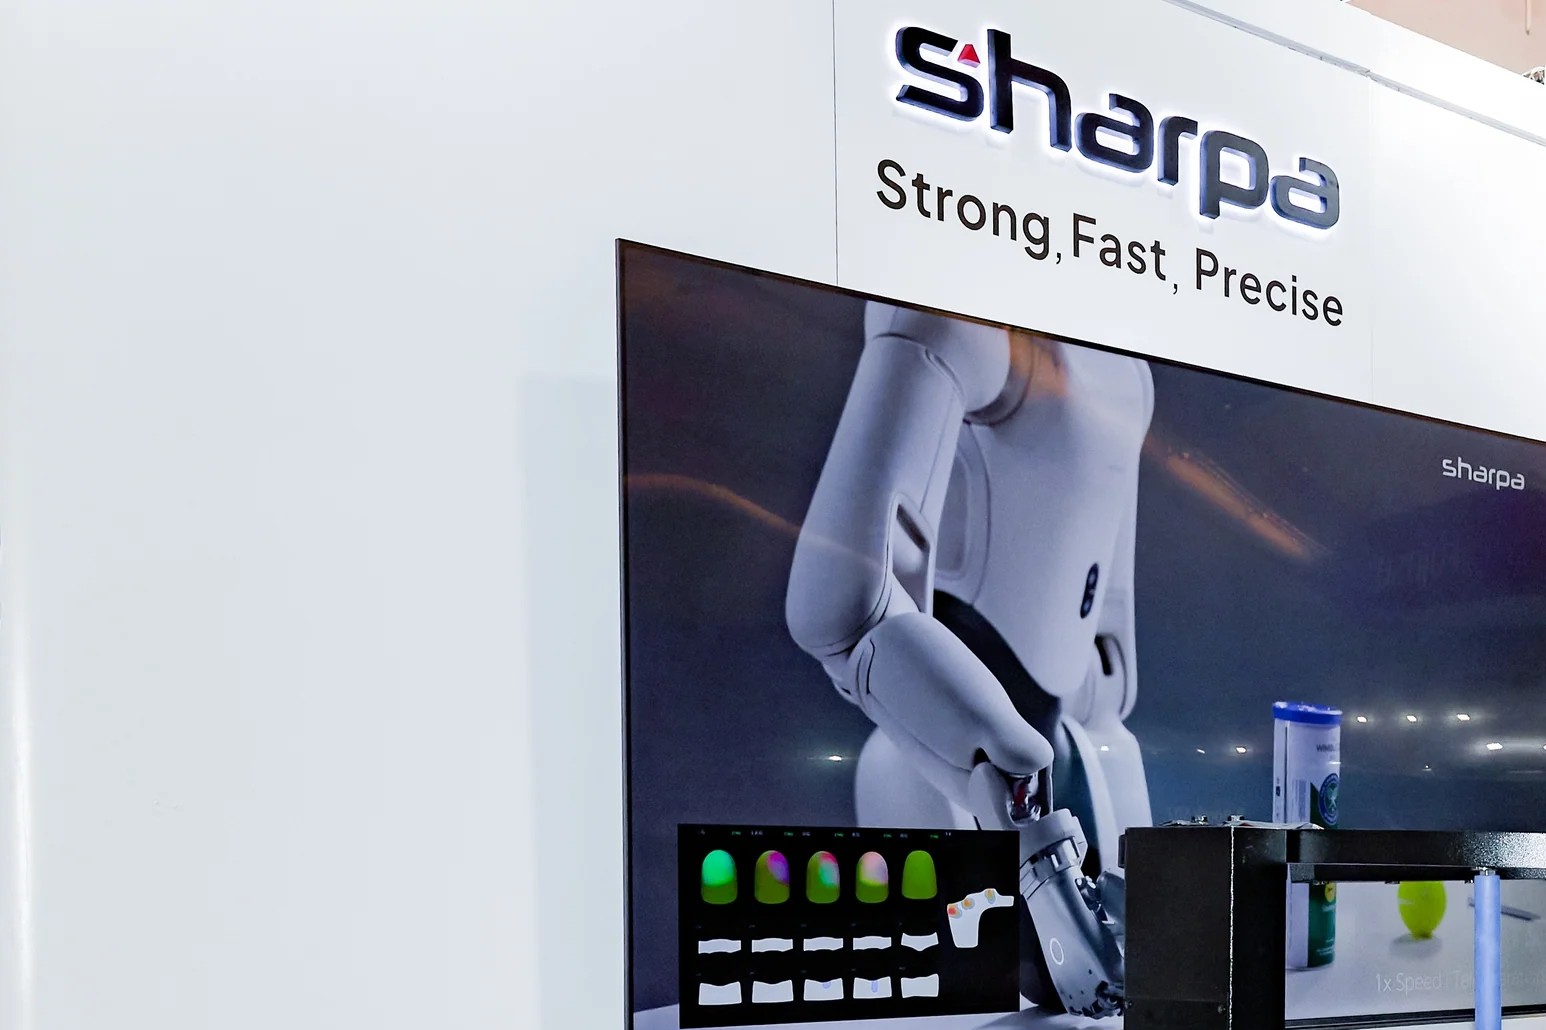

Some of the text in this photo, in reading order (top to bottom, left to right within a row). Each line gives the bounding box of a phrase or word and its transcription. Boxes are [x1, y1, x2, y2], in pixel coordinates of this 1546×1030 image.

[896, 26, 1340, 230] sharpa
[876, 160, 1343, 326] Strong, Fast, Precise
[1442, 456, 1525, 490] sharpa
